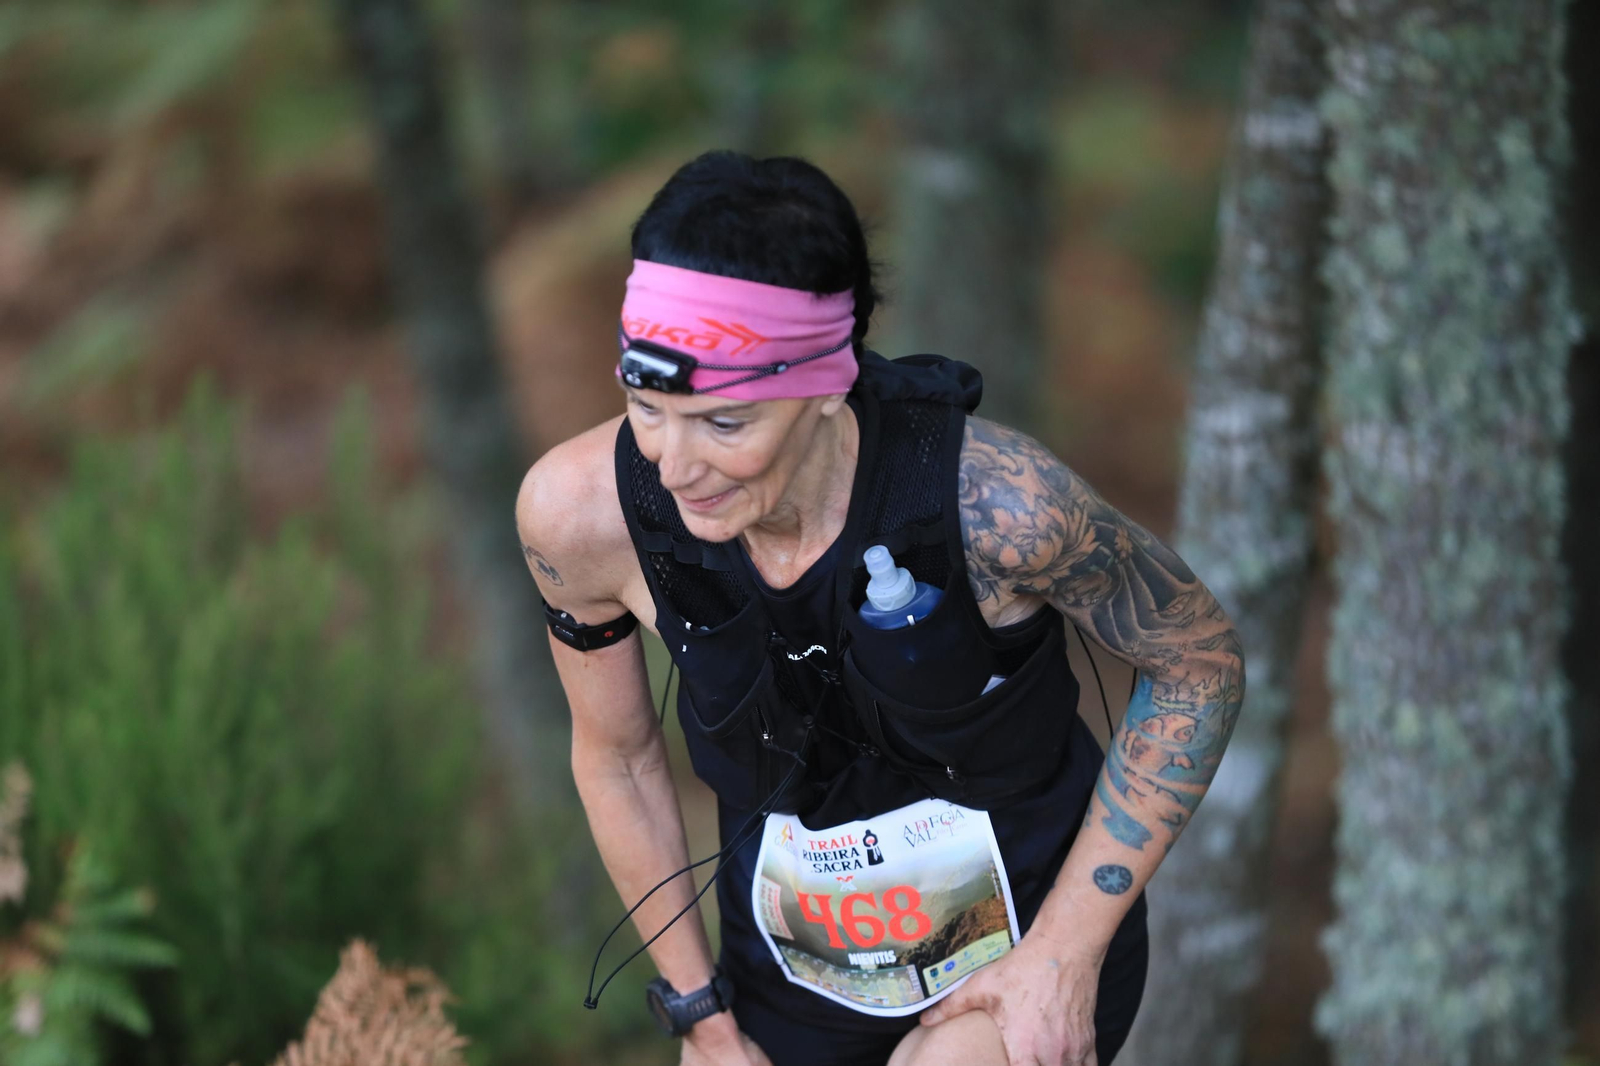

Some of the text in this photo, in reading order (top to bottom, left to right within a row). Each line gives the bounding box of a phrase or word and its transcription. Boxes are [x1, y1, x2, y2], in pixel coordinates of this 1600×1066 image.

[808, 834, 858, 851] TRAIL
[802, 846, 861, 862] RIBEIRA
[813, 859, 864, 874] SACRA
[797, 885, 932, 949] 468
